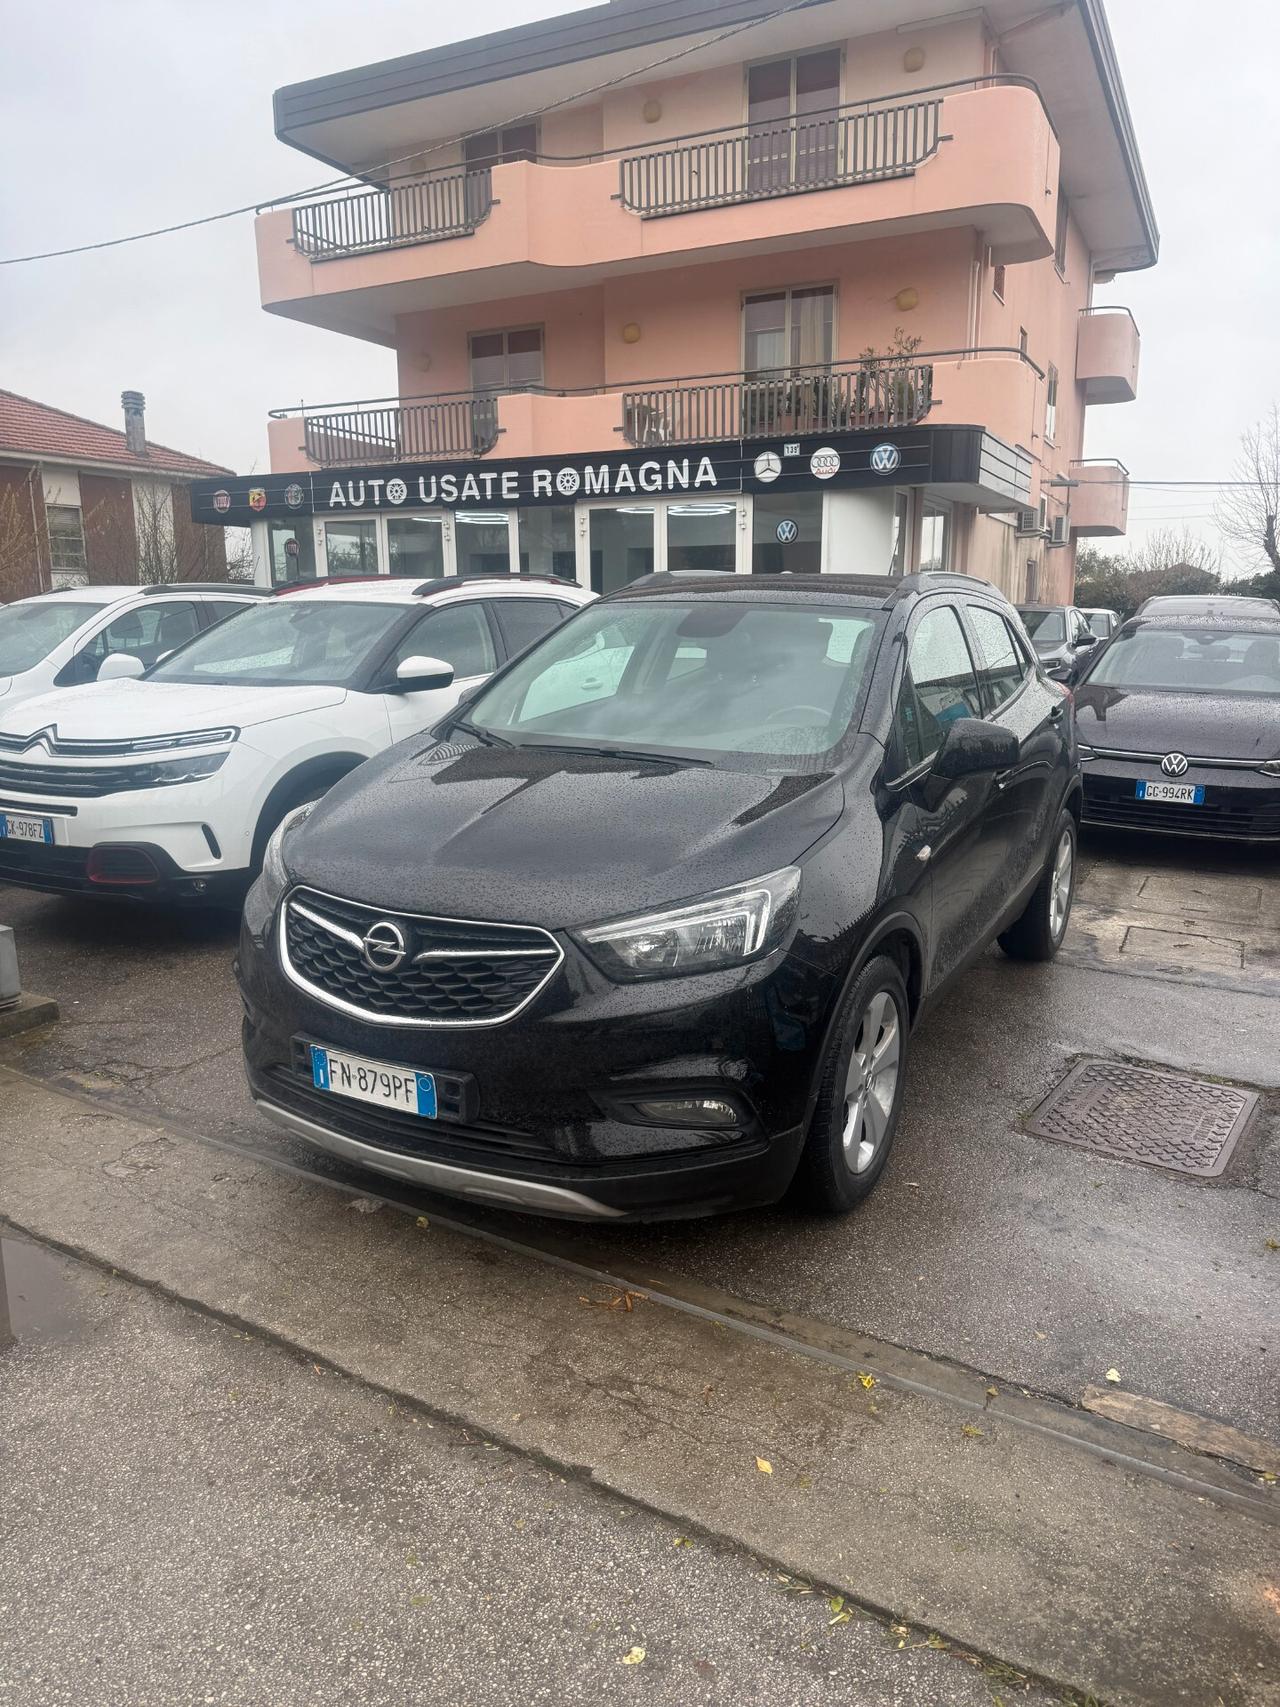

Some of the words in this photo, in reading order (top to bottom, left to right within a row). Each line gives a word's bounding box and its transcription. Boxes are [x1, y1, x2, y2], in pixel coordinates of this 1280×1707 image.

[329, 478, 408, 507] AUTO
[419, 471, 520, 503] USATE
[532, 456, 718, 498] ROMAGNA
